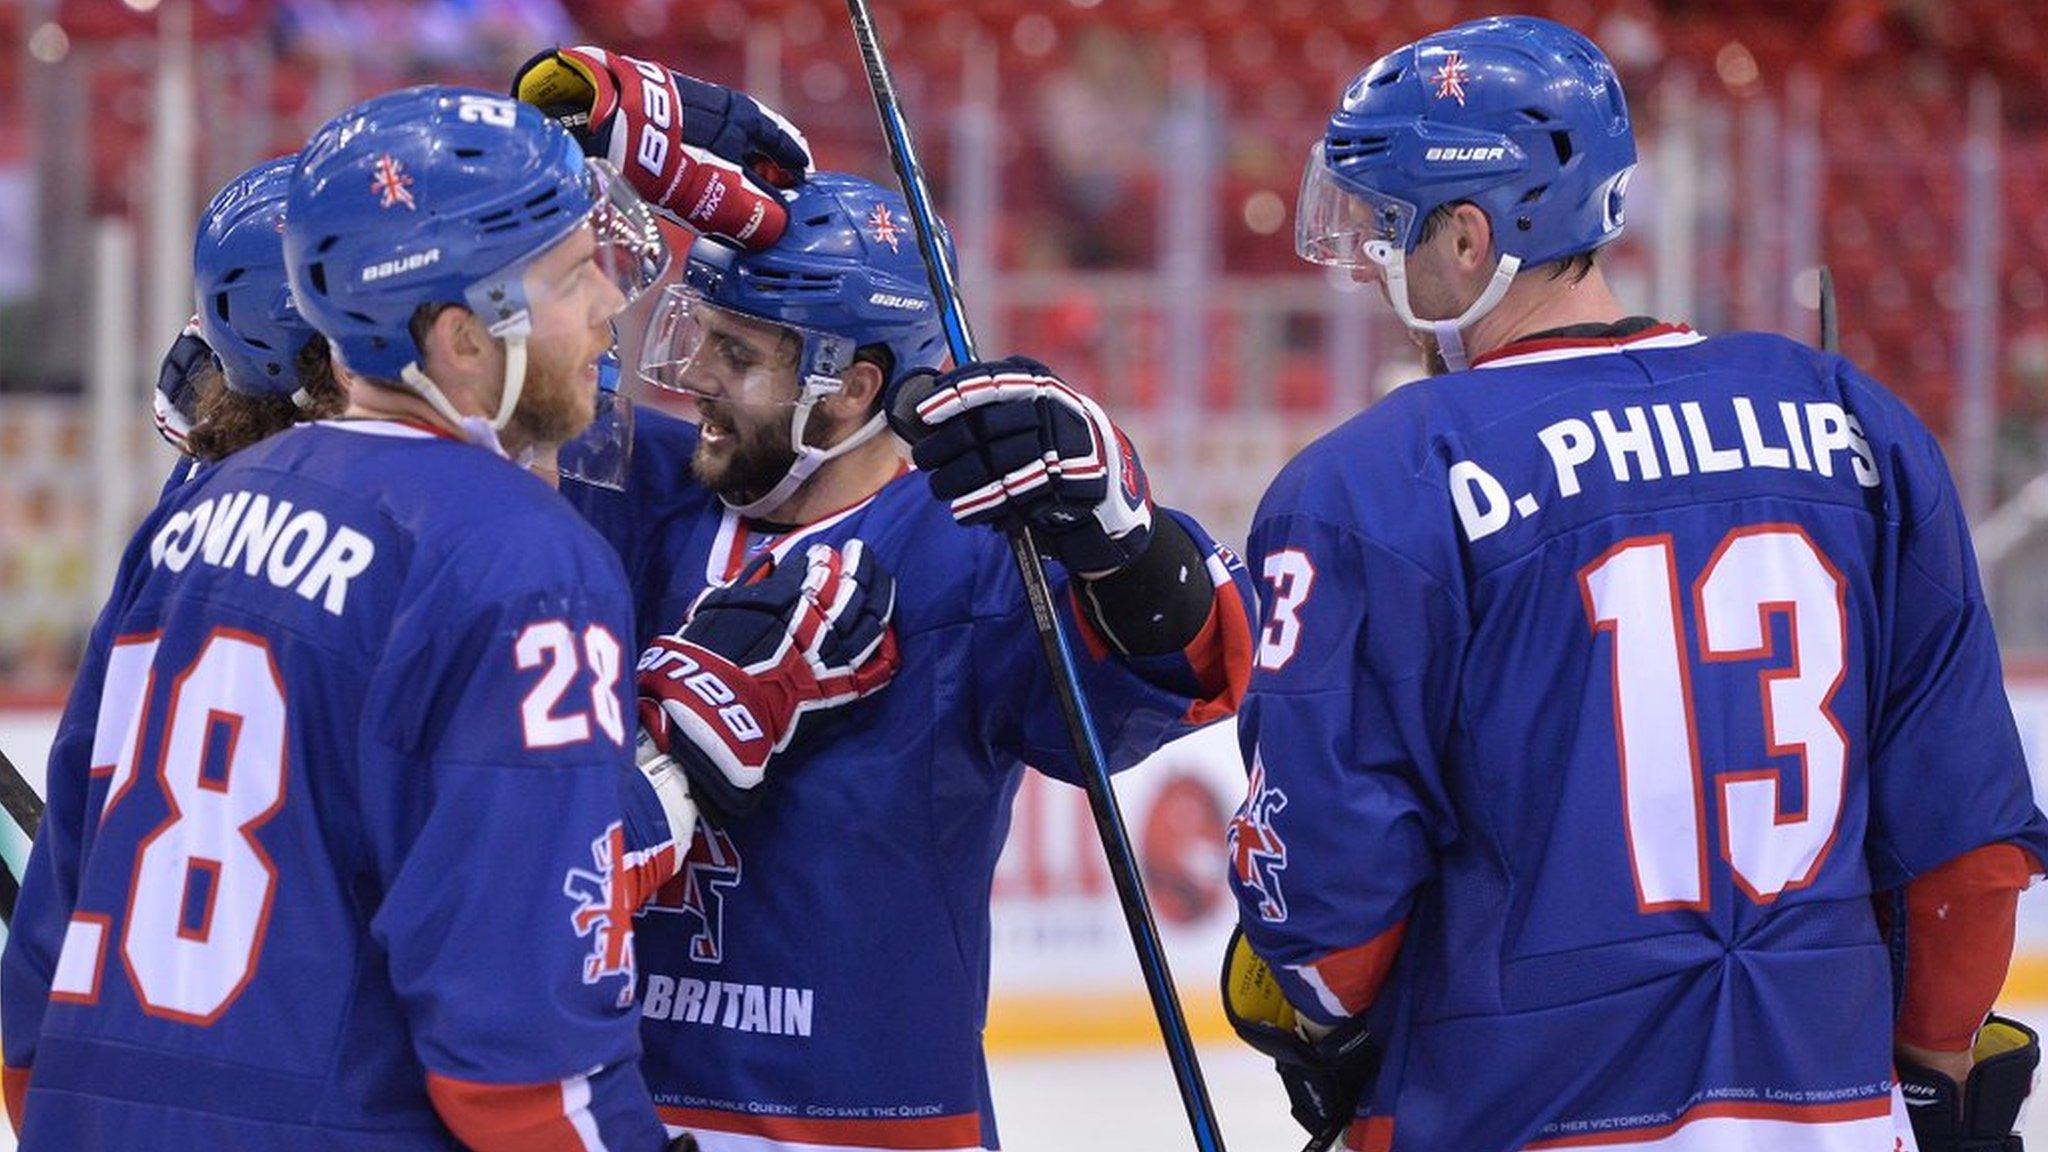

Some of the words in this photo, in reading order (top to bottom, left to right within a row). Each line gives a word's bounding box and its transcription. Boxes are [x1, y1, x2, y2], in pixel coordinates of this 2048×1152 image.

[700, 181, 727, 220] MX3
[1425, 147, 1505, 161] BAUER
[362, 248, 440, 282] BAUER
[1450, 460, 1540, 543] D.
[1538, 397, 1881, 499] PHILLIPS
[151, 490, 375, 616] CONNOR
[1253, 547, 1317, 672] 3
[515, 619, 627, 749] 28
[1577, 522, 1852, 914] 13
[642, 973, 814, 1036] BRITAIN
[837, 1106, 870, 1117] SAVE
[872, 1106, 897, 1117] THE
